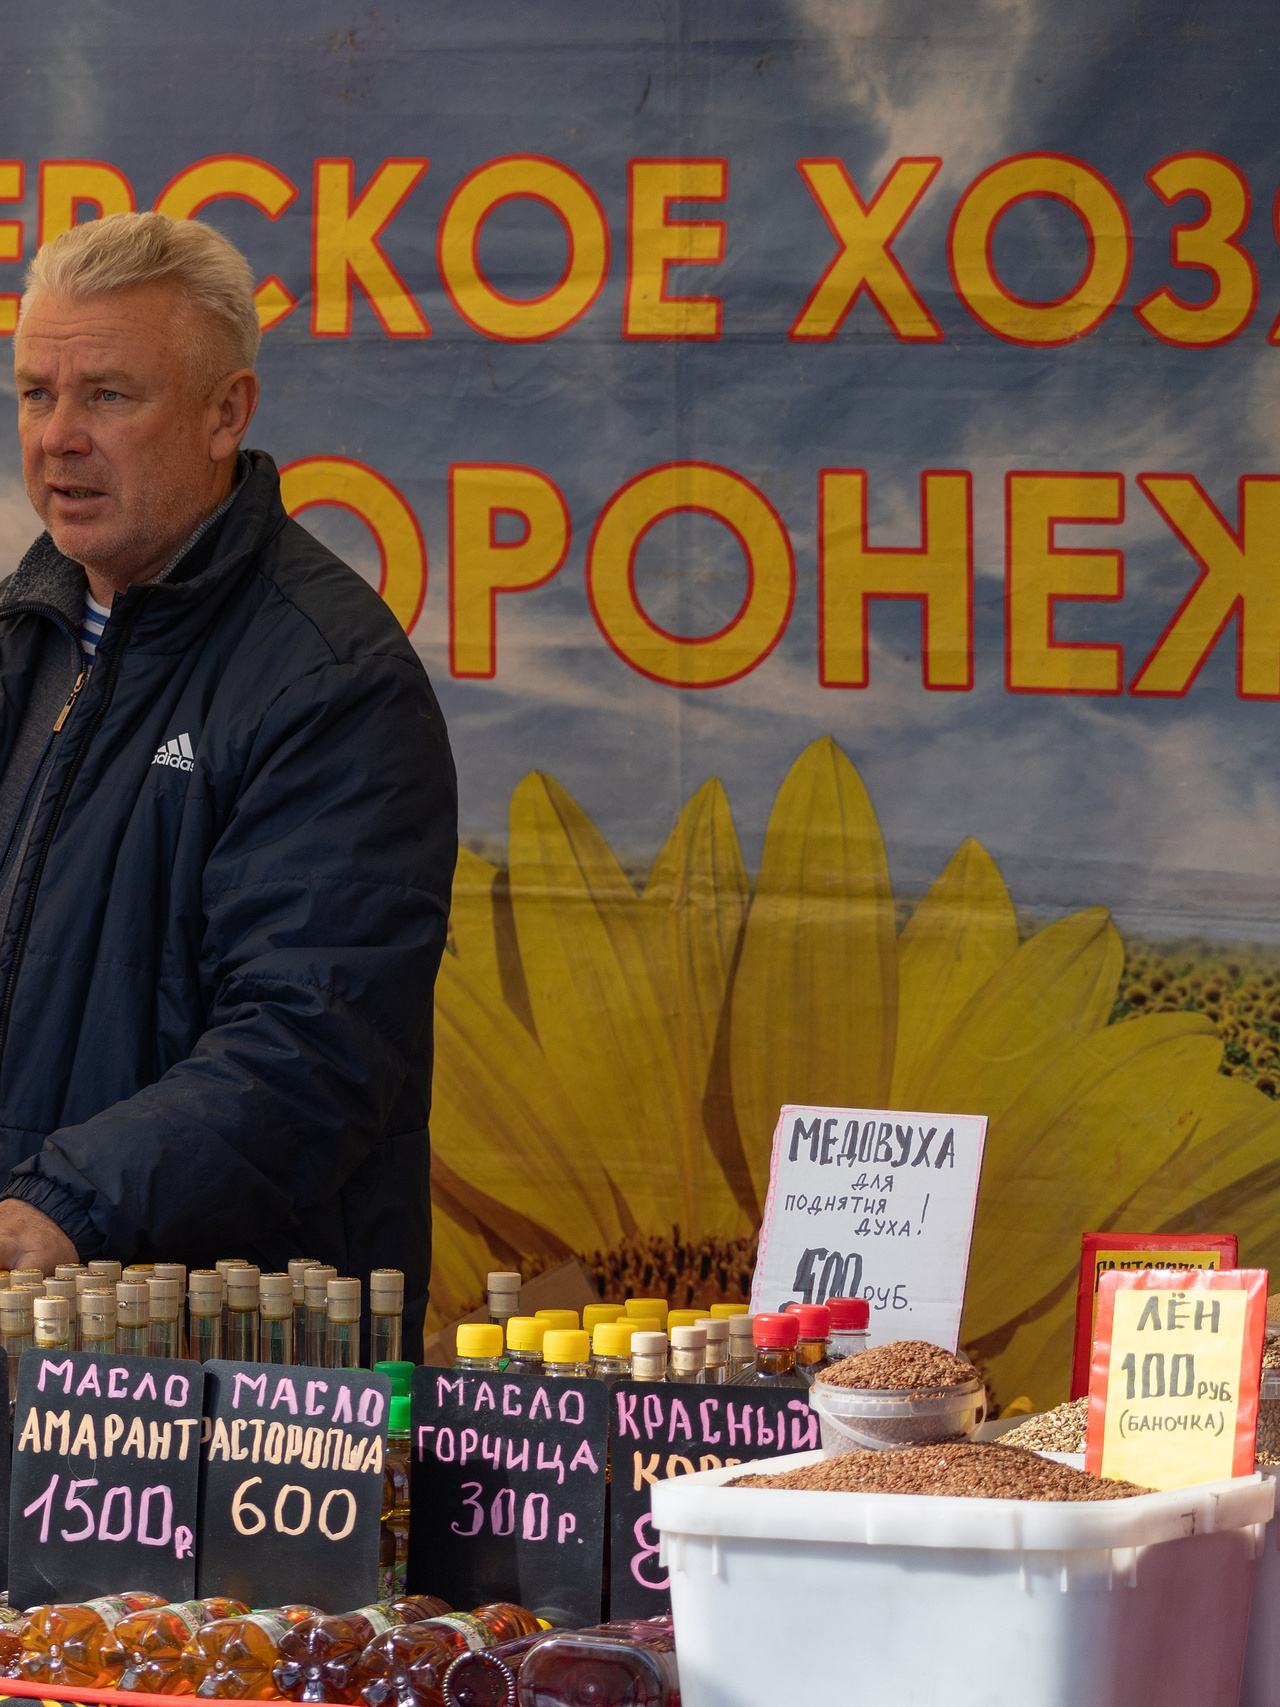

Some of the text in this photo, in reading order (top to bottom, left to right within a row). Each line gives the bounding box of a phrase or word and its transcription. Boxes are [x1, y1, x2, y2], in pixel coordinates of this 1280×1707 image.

[786, 150, 1280, 349] ХОЗ
[788, 1117, 955, 1169] МЕДОВУХА
[851, 1173, 894, 1192] ДЛЯ
[1136, 1292, 1221, 1333] ЛЁН
[37, 1358, 189, 1407] МАСЛО
[232, 1372, 385, 1427] МАСЛО
[436, 1374, 585, 1425] МАСЛО
[1121, 1353, 1195, 1400] 100
[17, 1406, 199, 1461] АМАРАНТ
[615, 1391, 819, 1450] КРАСНЫЙ
[1119, 1409, 1225, 1439] (БАНОЧКА)
[418, 1425, 599, 1485] ГОРЧИЦА
[231, 1476, 357, 1541] 600
